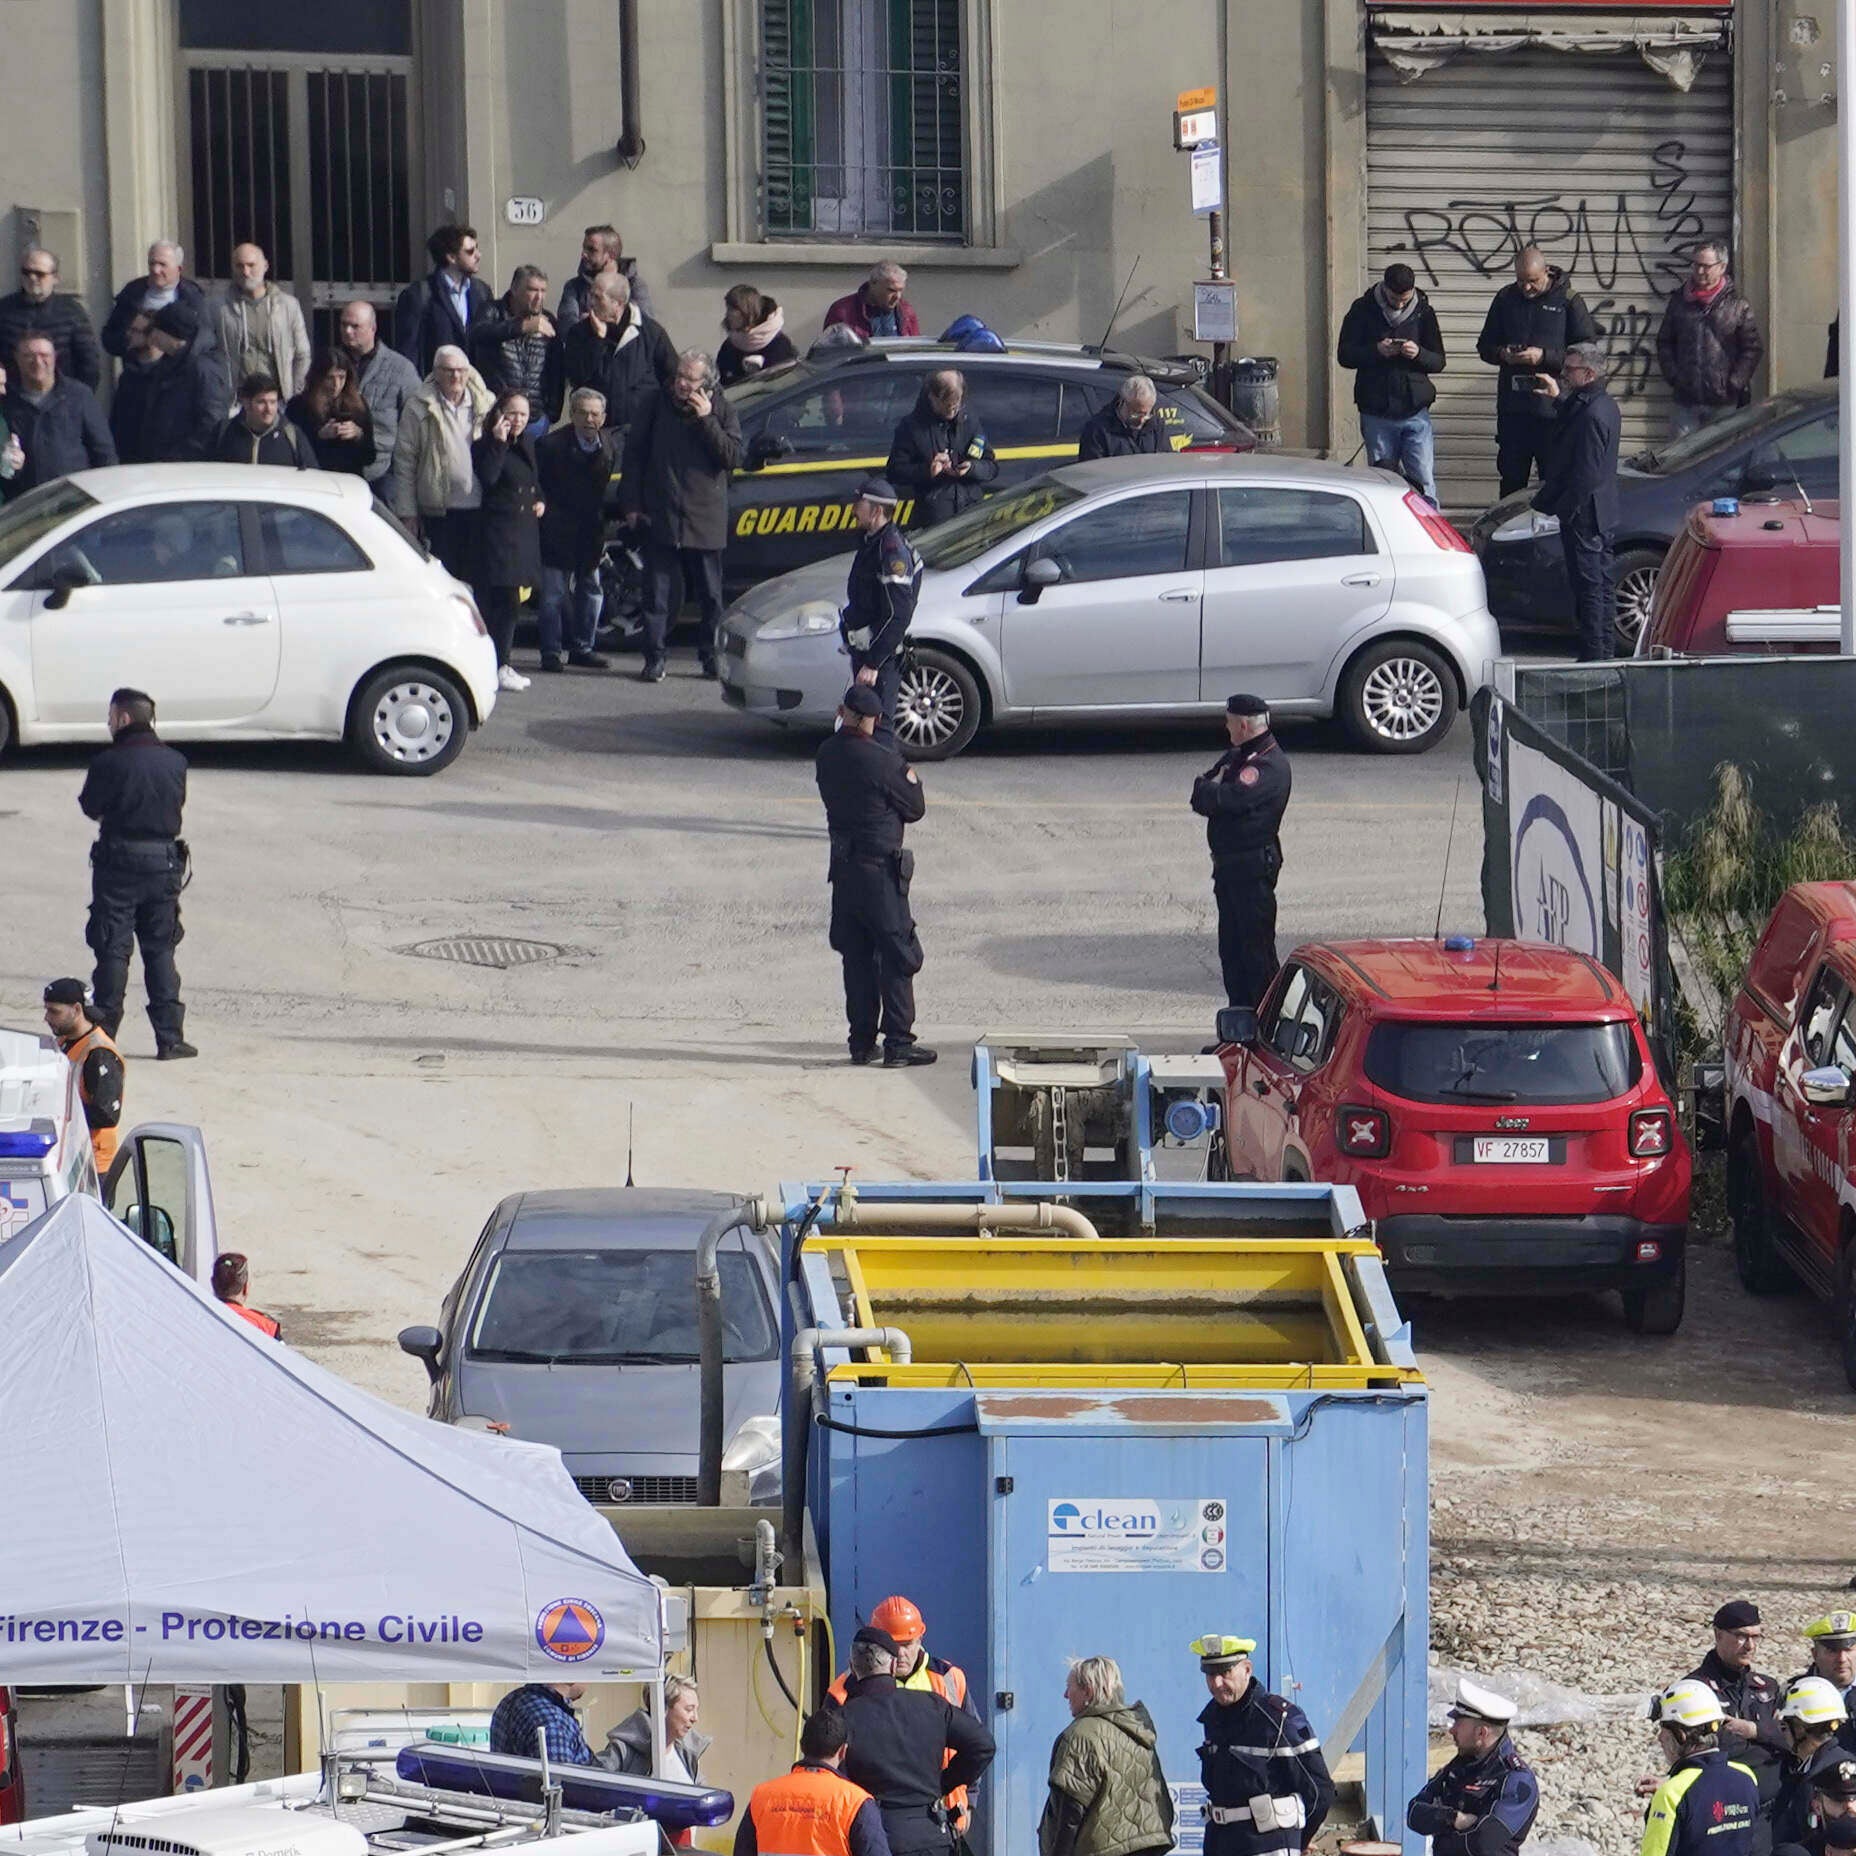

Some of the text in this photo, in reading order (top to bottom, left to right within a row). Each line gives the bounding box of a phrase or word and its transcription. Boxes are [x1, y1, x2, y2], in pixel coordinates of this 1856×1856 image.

[514, 201, 537, 219] 36
[736, 504, 859, 536] GUARDI
[1477, 1141, 1545, 1159] VF 27857
[1080, 1509, 1156, 1530] clean
[161, 1612, 366, 1642] Protezione
[378, 1615, 484, 1643] Civile
